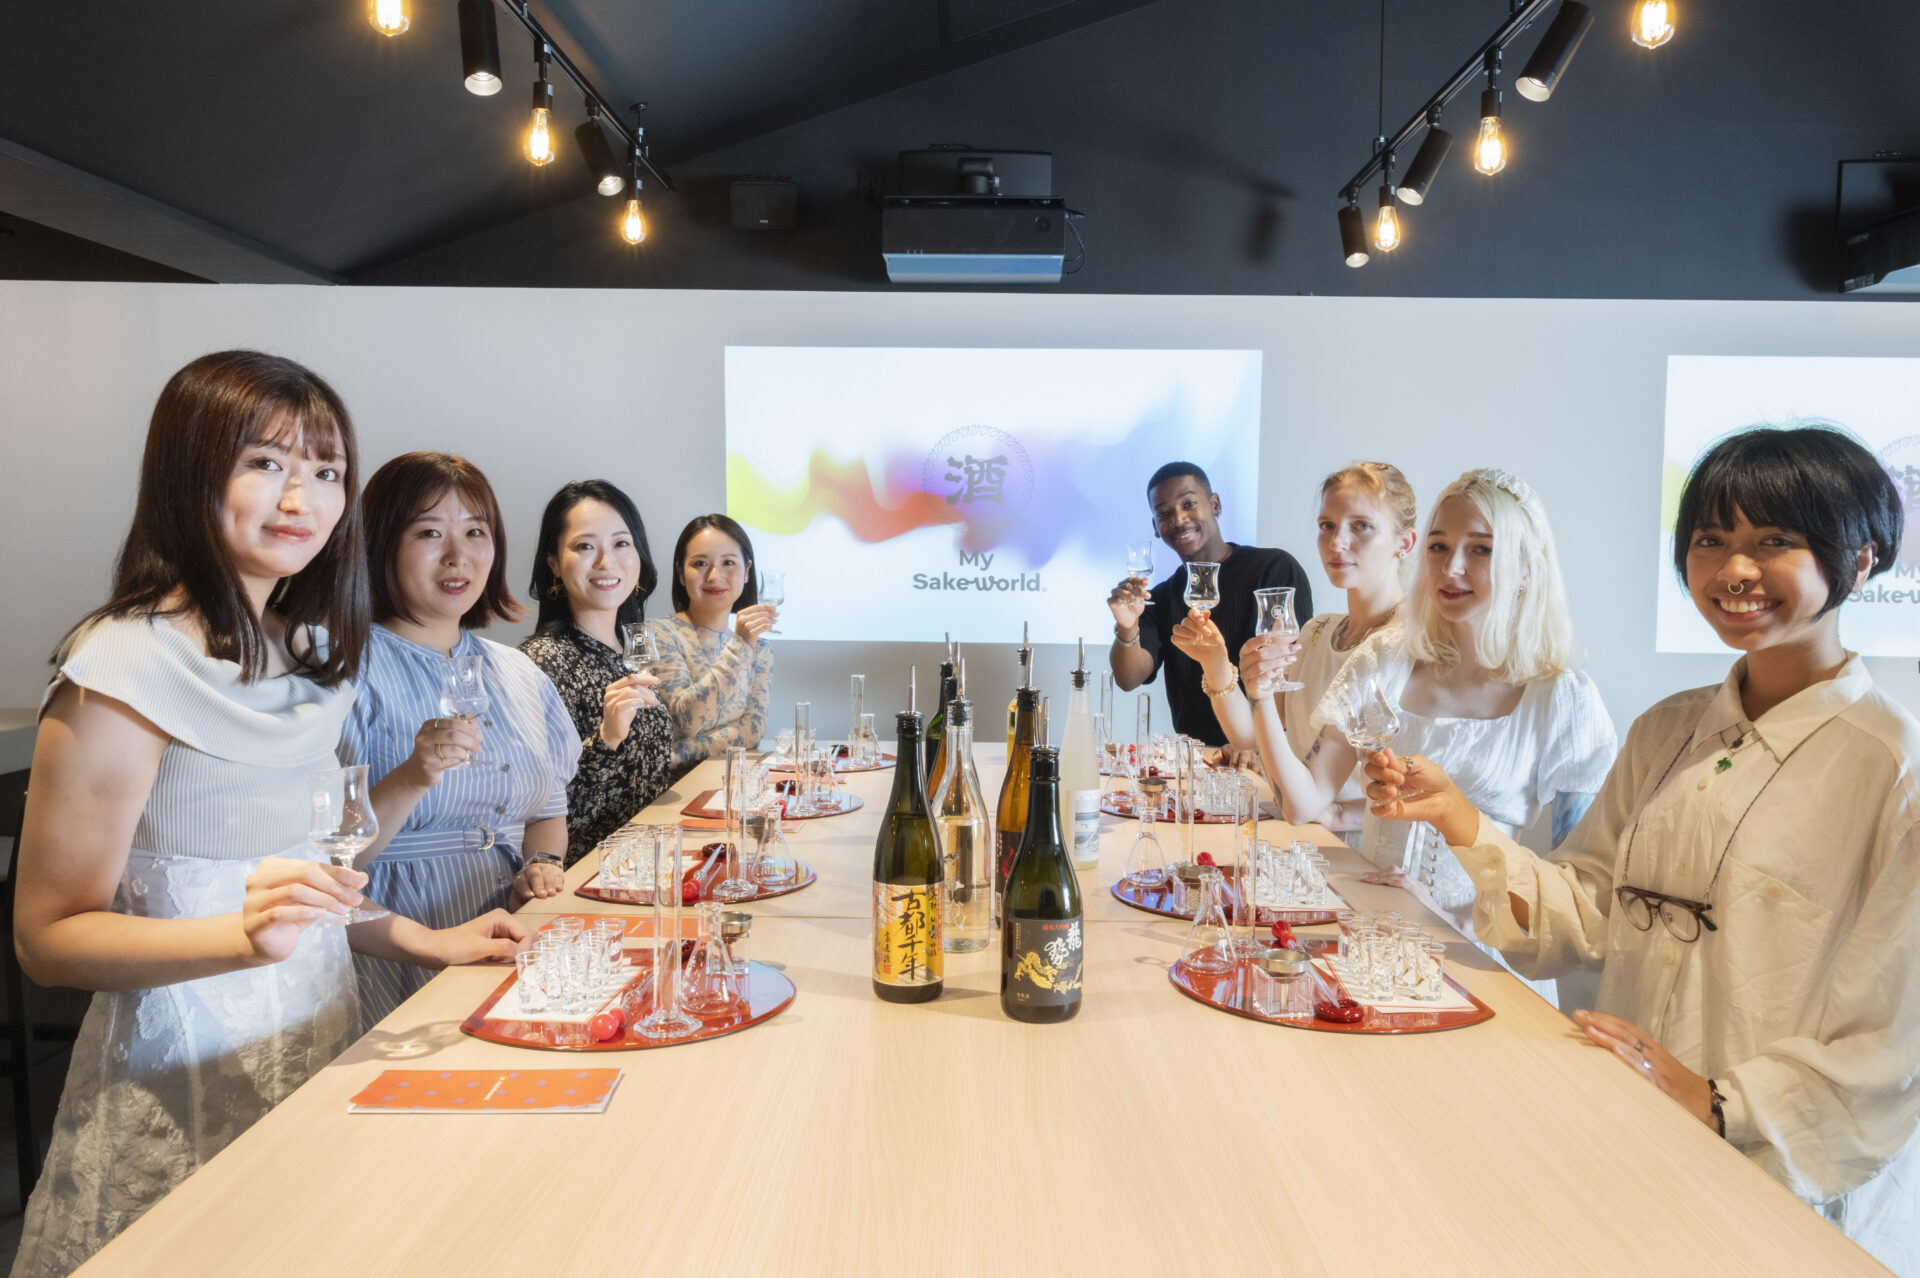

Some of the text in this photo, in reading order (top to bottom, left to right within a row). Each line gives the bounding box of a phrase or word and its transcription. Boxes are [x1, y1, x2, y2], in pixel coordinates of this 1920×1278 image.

[944, 454, 1009, 505] 酒
[959, 549, 994, 571] My
[891, 888, 926, 980] 古都千年
